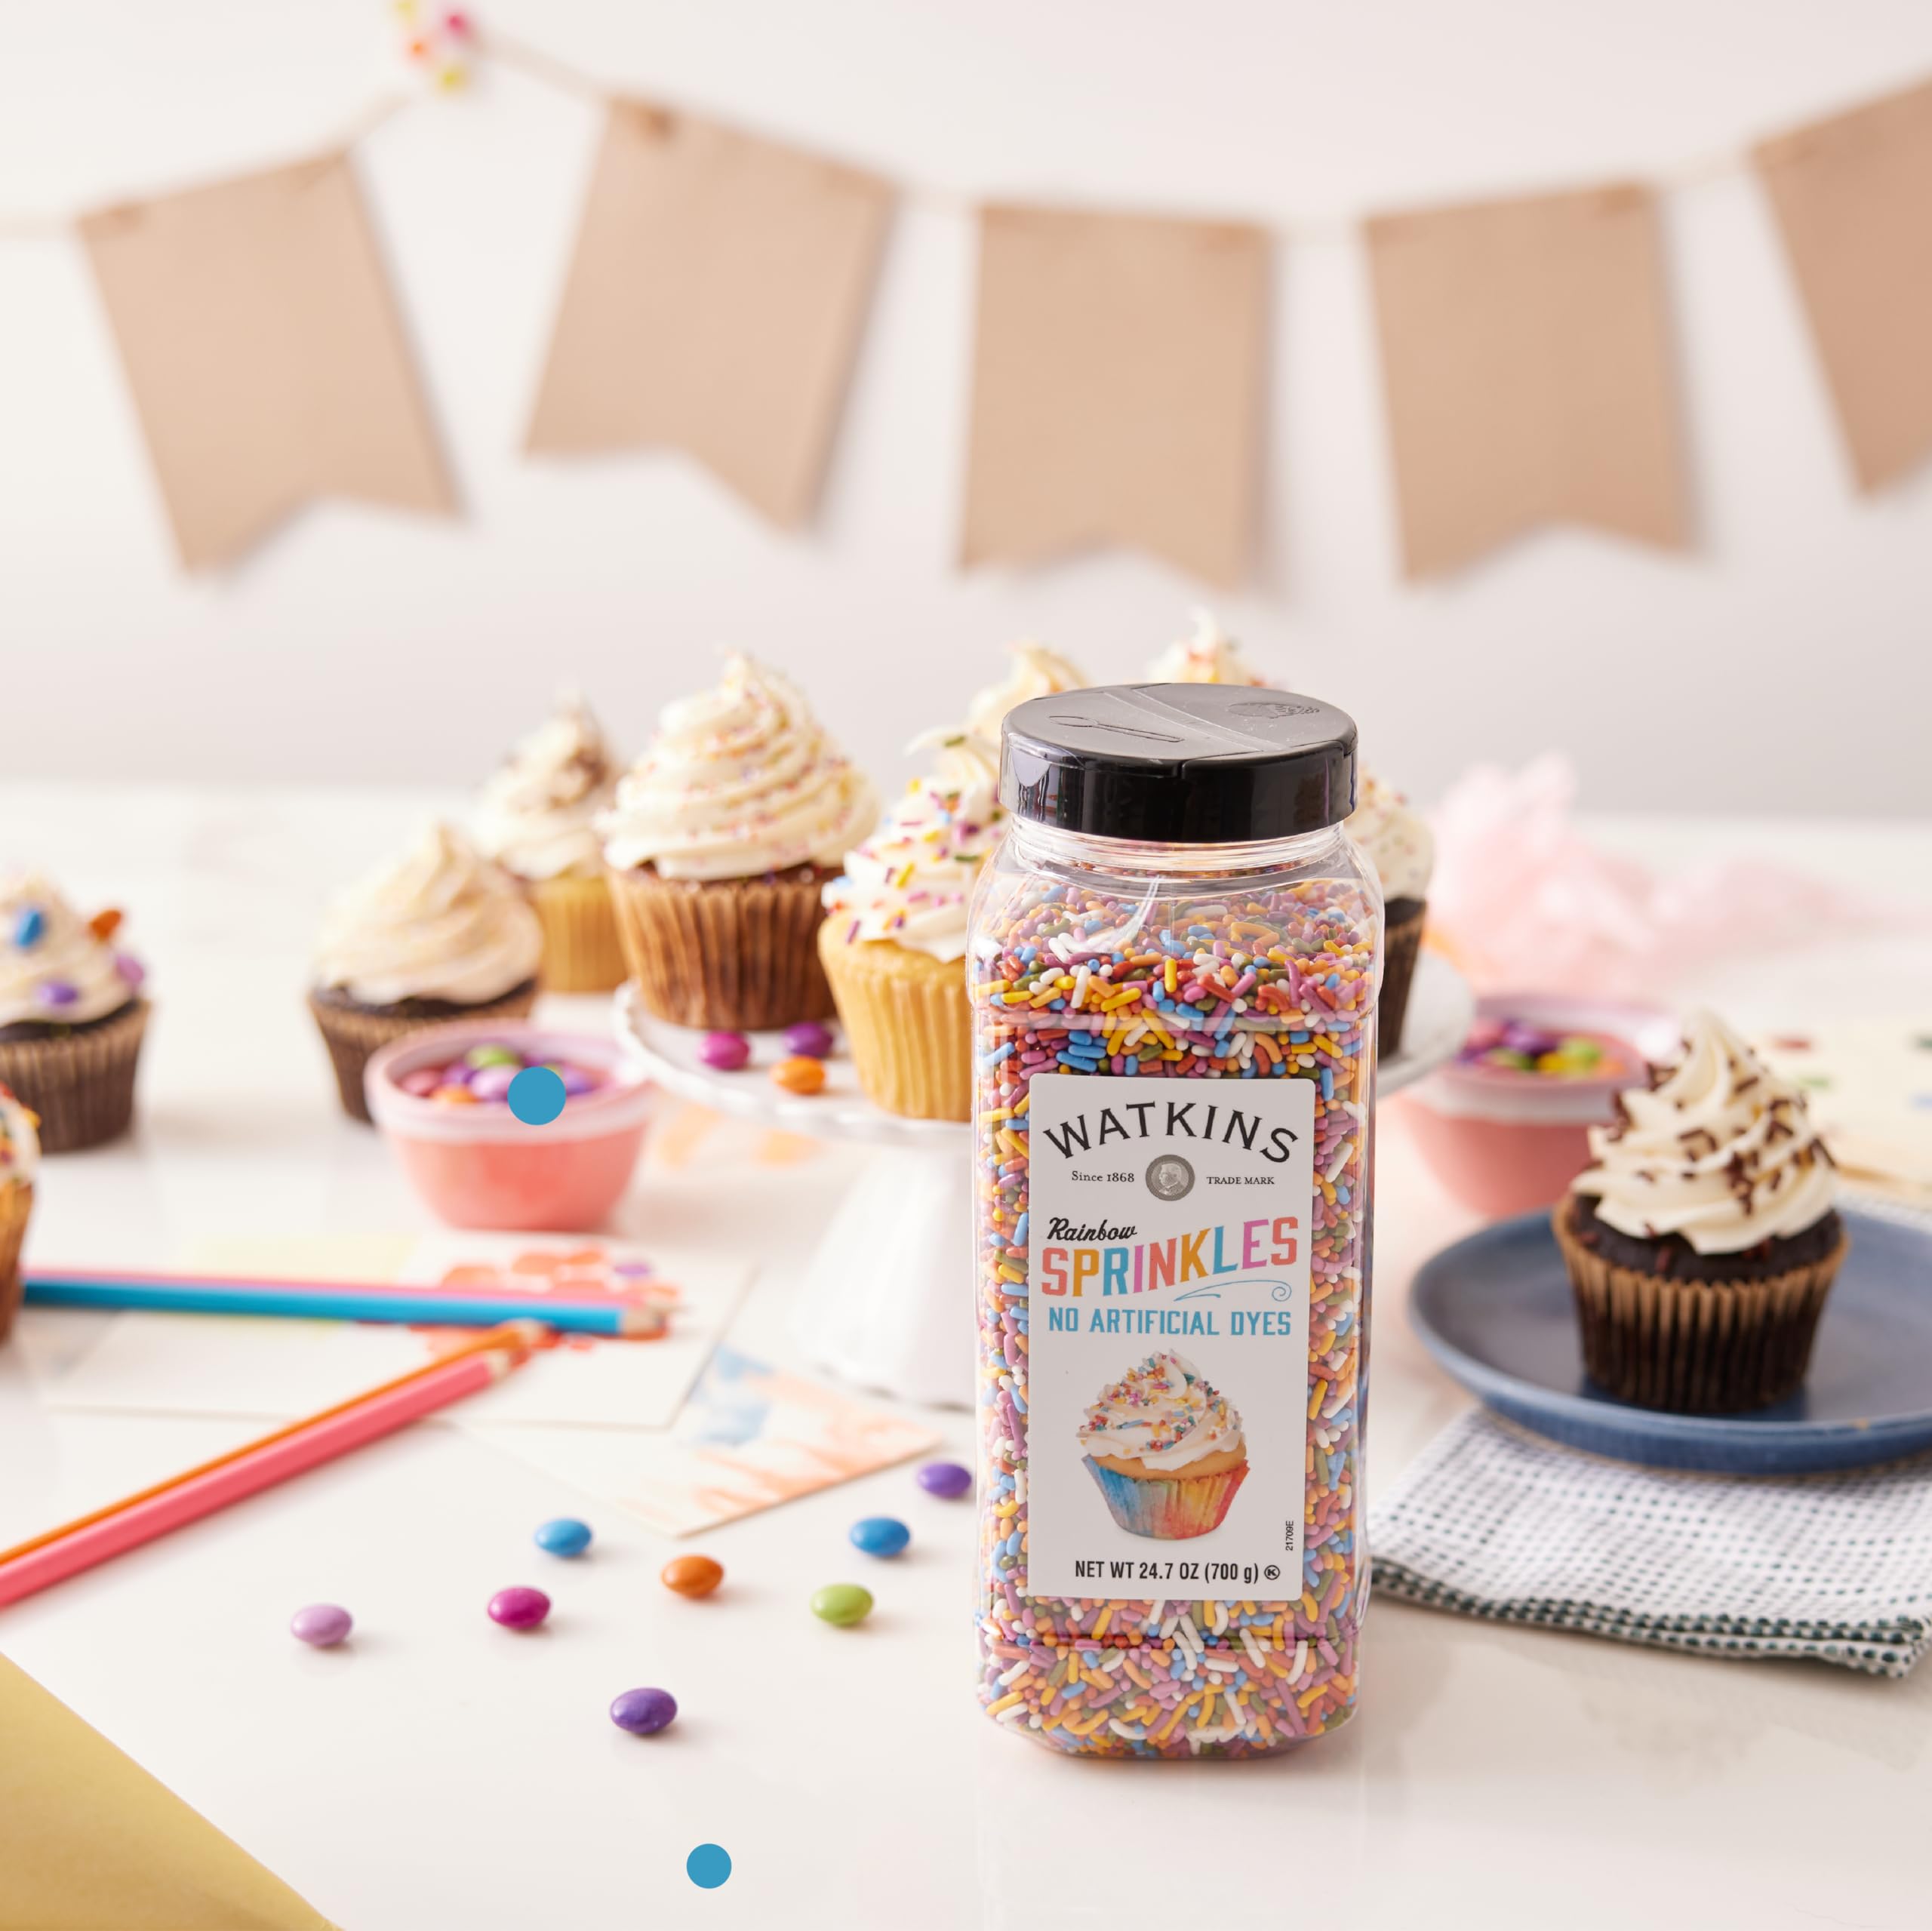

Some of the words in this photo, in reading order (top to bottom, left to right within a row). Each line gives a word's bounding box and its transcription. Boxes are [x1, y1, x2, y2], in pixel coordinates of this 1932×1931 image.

[1043, 1101, 1299, 1163] WATKINS
[1071, 1170, 1103, 1182] Since
[1106, 1172, 1135, 1183] 1868
[1206, 1176, 1241, 1185] TRADE
[1244, 1176, 1275, 1185] MARK
[1047, 1216, 1137, 1242] Rainbow
[1041, 1216, 1299, 1297] SPRINKLES
[1049, 1307, 1078, 1332] NO
[1089, 1308, 1220, 1336] ARTIFICIAL
[1230, 1311, 1291, 1336] DYES
[1284, 1520, 1294, 1551] 21709E
[1075, 1560, 1104, 1578] NET
[1109, 1561, 1134, 1579] WT
[1139, 1562, 1174, 1579] 24.7
[1179, 1563, 1199, 1579] OZ
[1204, 1564, 1238, 1583] (700
[1243, 1564, 1259, 1584] g)
